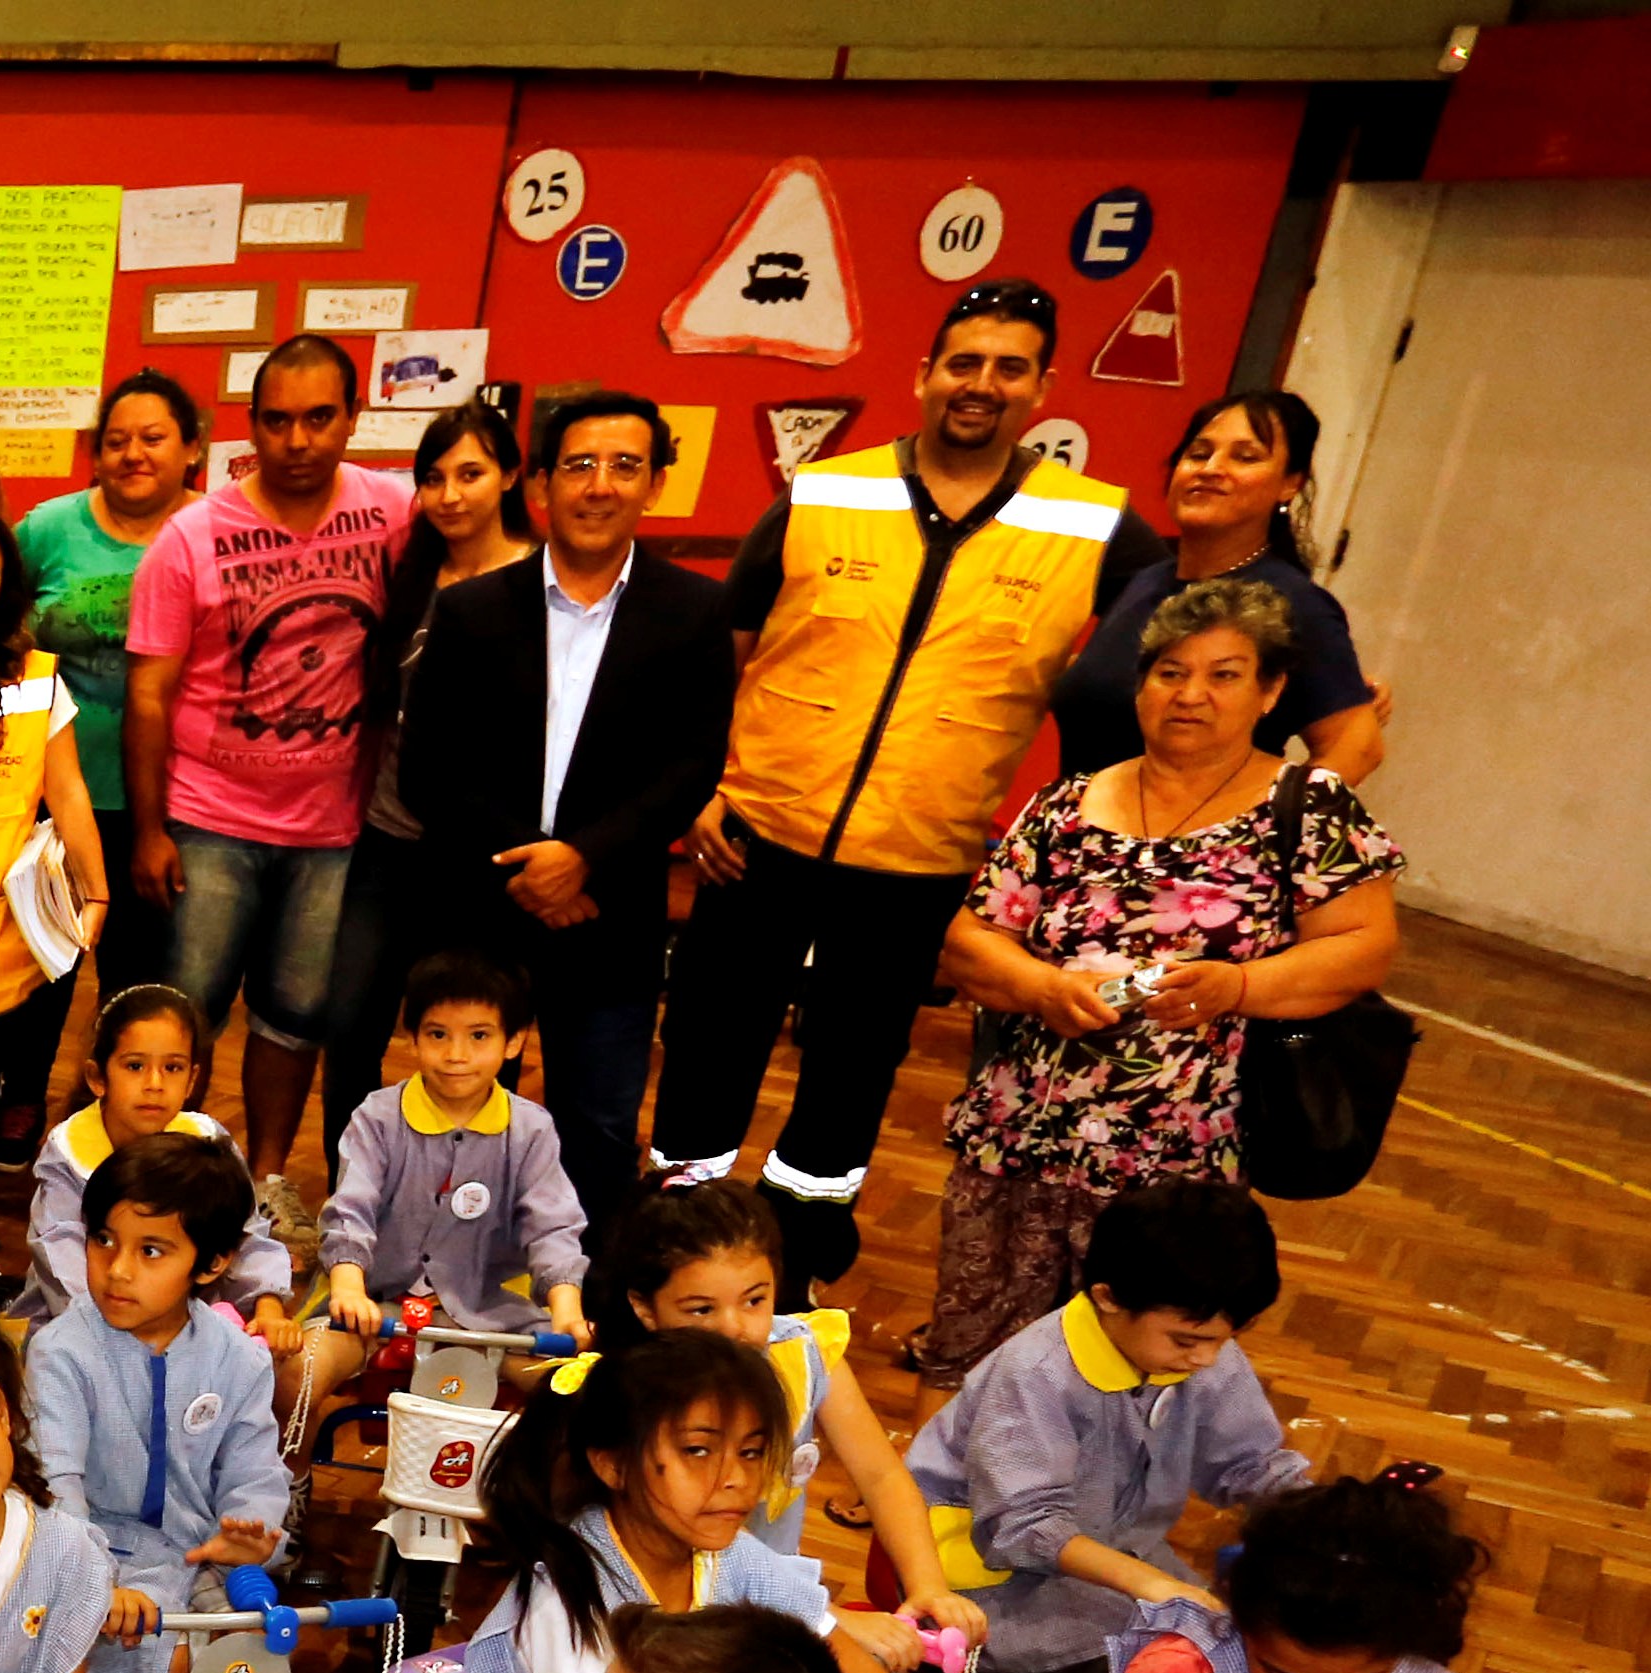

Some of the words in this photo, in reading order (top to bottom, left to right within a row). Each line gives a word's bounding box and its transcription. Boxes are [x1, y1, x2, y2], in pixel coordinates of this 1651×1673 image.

[524, 171, 569, 217] 25
[938, 213, 984, 254] 60
[1084, 201, 1138, 262] E
[578, 231, 612, 292] E
